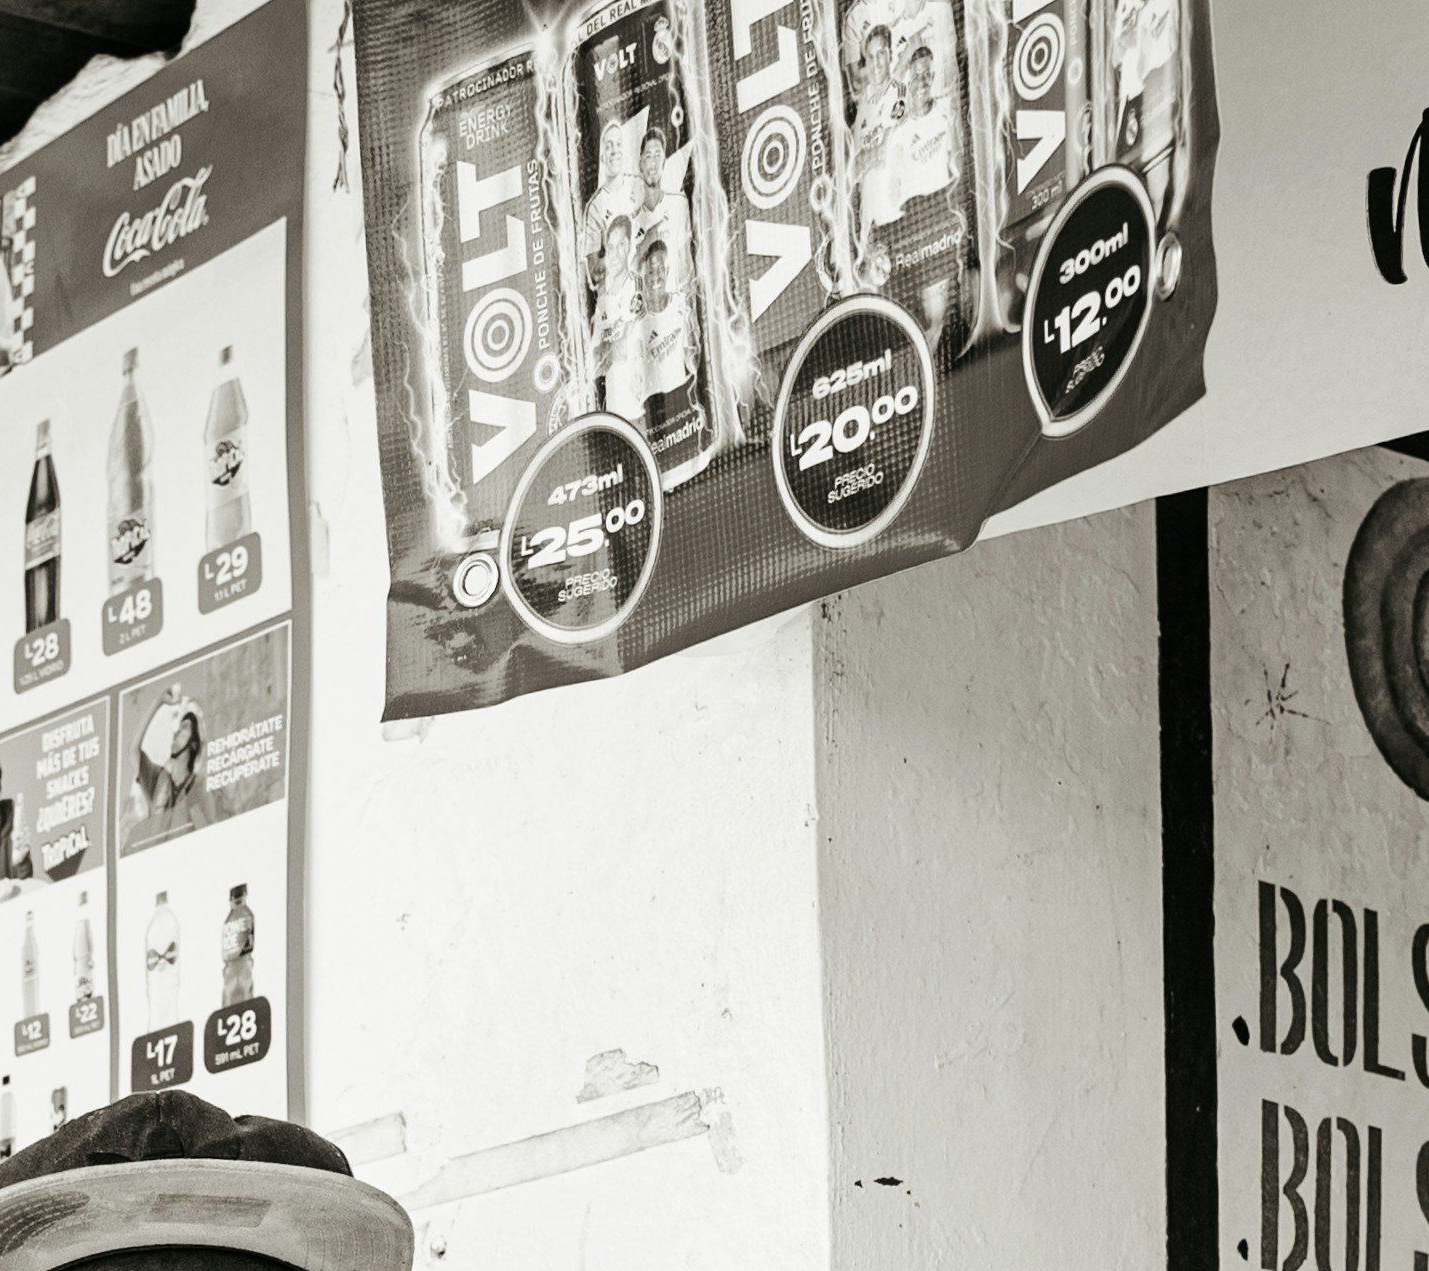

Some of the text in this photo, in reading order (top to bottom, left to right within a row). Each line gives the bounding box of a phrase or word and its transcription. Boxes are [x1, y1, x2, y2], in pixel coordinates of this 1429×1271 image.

[593, 42, 638, 82] VOLT
[804, 48, 819, 78] DE
[132, 112, 152, 152] EN
[465, 121, 510, 150] DRINK
[806, 80, 827, 171] PONCHE
[133, 133, 182, 191] ASADO
[526, 159, 551, 351] PONCHE DE FRUTAS
[1059, 222, 1129, 285] 300ml
[456, 160, 537, 486] VOLT
[812, 348, 892, 400] 625ml
[547, 463, 624, 506] 473ml
[827, 471, 884, 504] SUGERIDO
[834, 463, 876, 490] PRECIO
[557, 576, 618, 602] SUGERIDO
[565, 568, 611, 589] PRECIO
[42, 713, 95, 754] DISFRUTA
[36, 736, 100, 780] MÁS DE TUS
[46, 766, 90, 800] SNACKS
